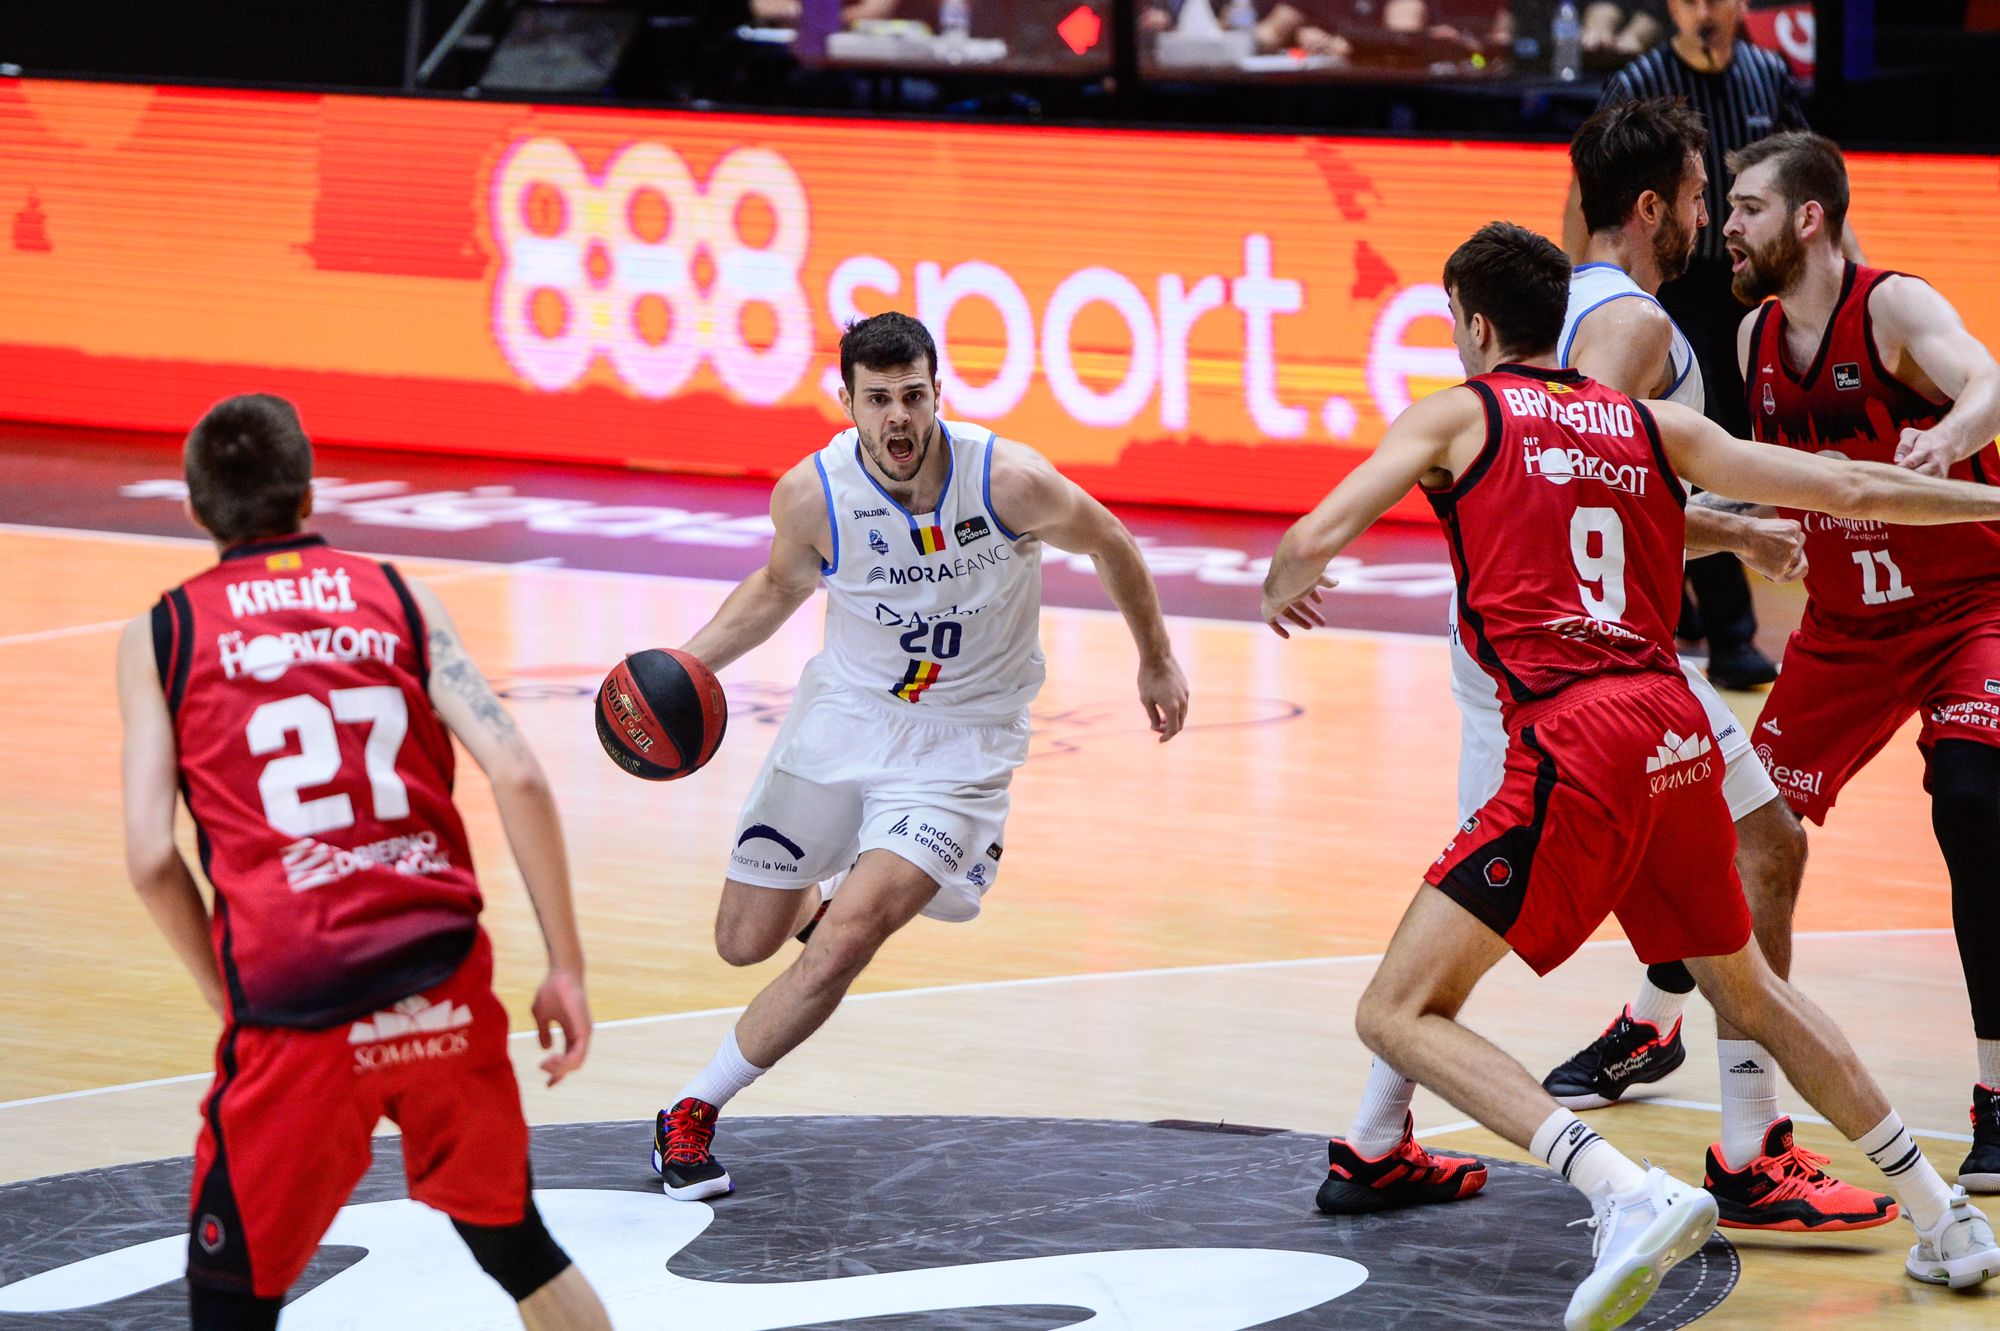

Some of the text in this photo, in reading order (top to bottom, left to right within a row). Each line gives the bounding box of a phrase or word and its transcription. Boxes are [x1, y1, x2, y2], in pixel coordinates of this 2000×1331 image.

[853, 508, 890, 520] SPALDING
[1570, 506, 1626, 623] 9
[1852, 549, 1915, 605] 11
[900, 620, 962, 660] 20
[246, 685, 411, 838] 27
[914, 832, 958, 873] telecom
[919, 822, 964, 859] andorra
[762, 860, 771, 870] la
[774, 861, 798, 873] Vella
